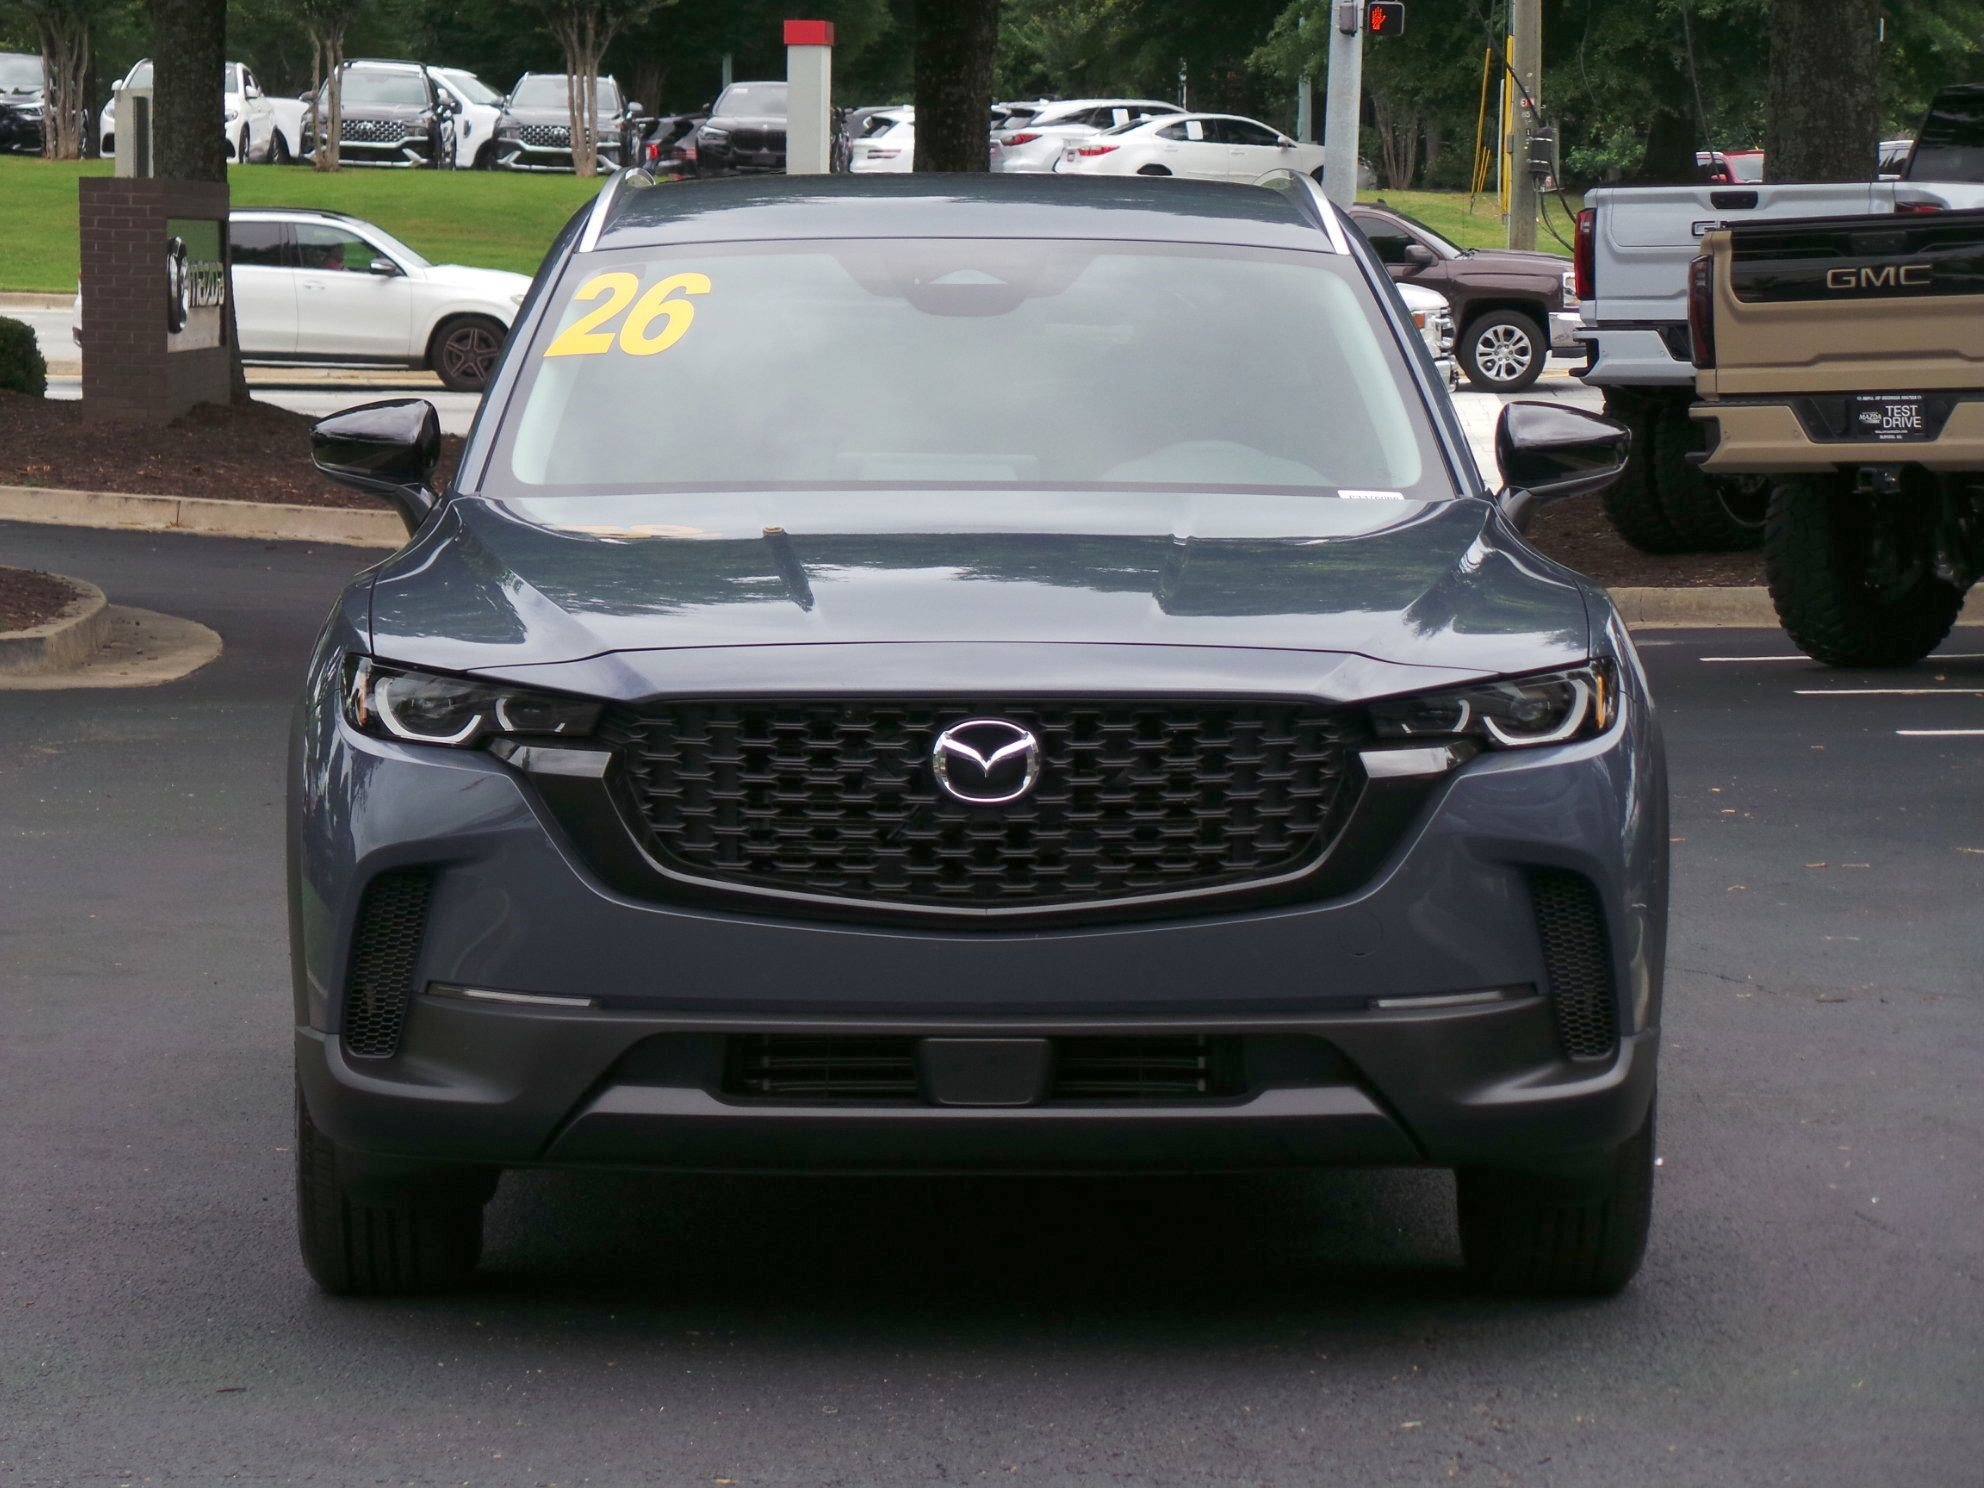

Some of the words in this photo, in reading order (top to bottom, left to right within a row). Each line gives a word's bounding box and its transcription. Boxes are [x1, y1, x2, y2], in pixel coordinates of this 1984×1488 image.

[1826, 264, 1931, 289] GMC
[543, 271, 712, 357] 26
[1885, 405, 1918, 417] TEST
[1883, 416, 1922, 428] DRIVE
